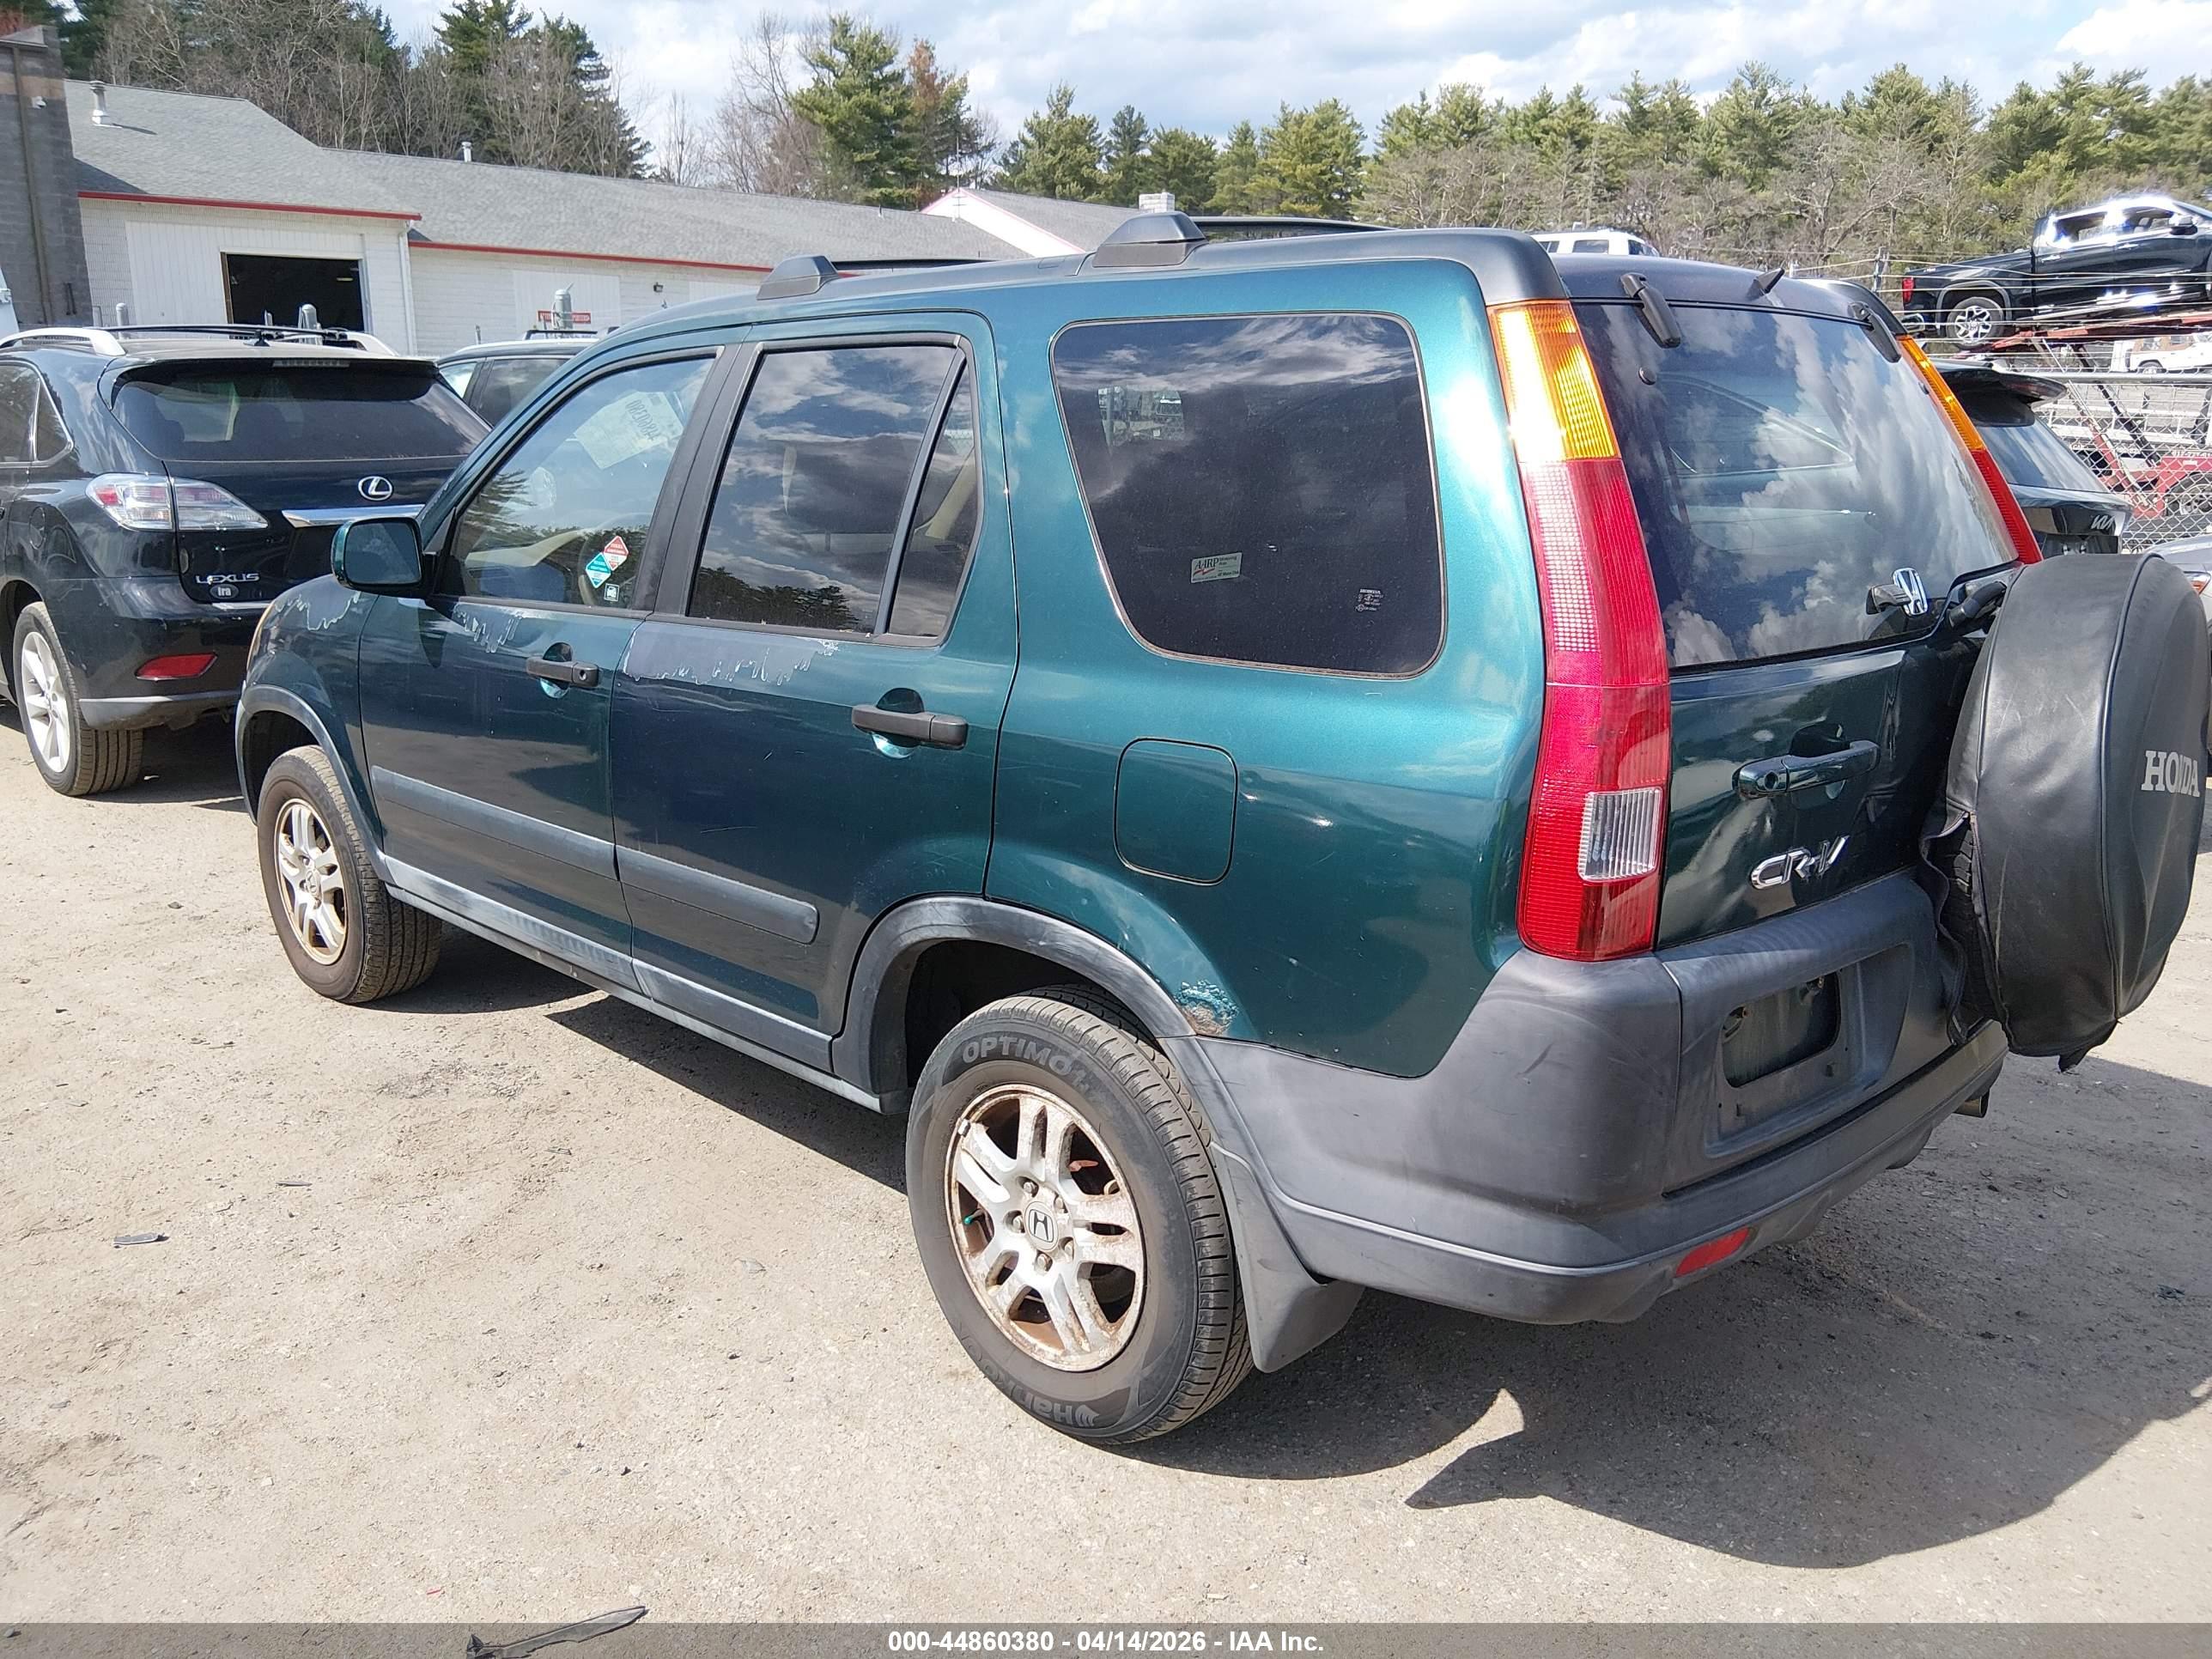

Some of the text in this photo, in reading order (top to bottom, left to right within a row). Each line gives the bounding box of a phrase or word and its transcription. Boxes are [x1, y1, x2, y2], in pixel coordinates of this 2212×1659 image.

[195, 573, 260, 585] LEXUS
[1751, 836, 1850, 890] CR-V
[962, 1035, 1073, 1077] OPTIMO
